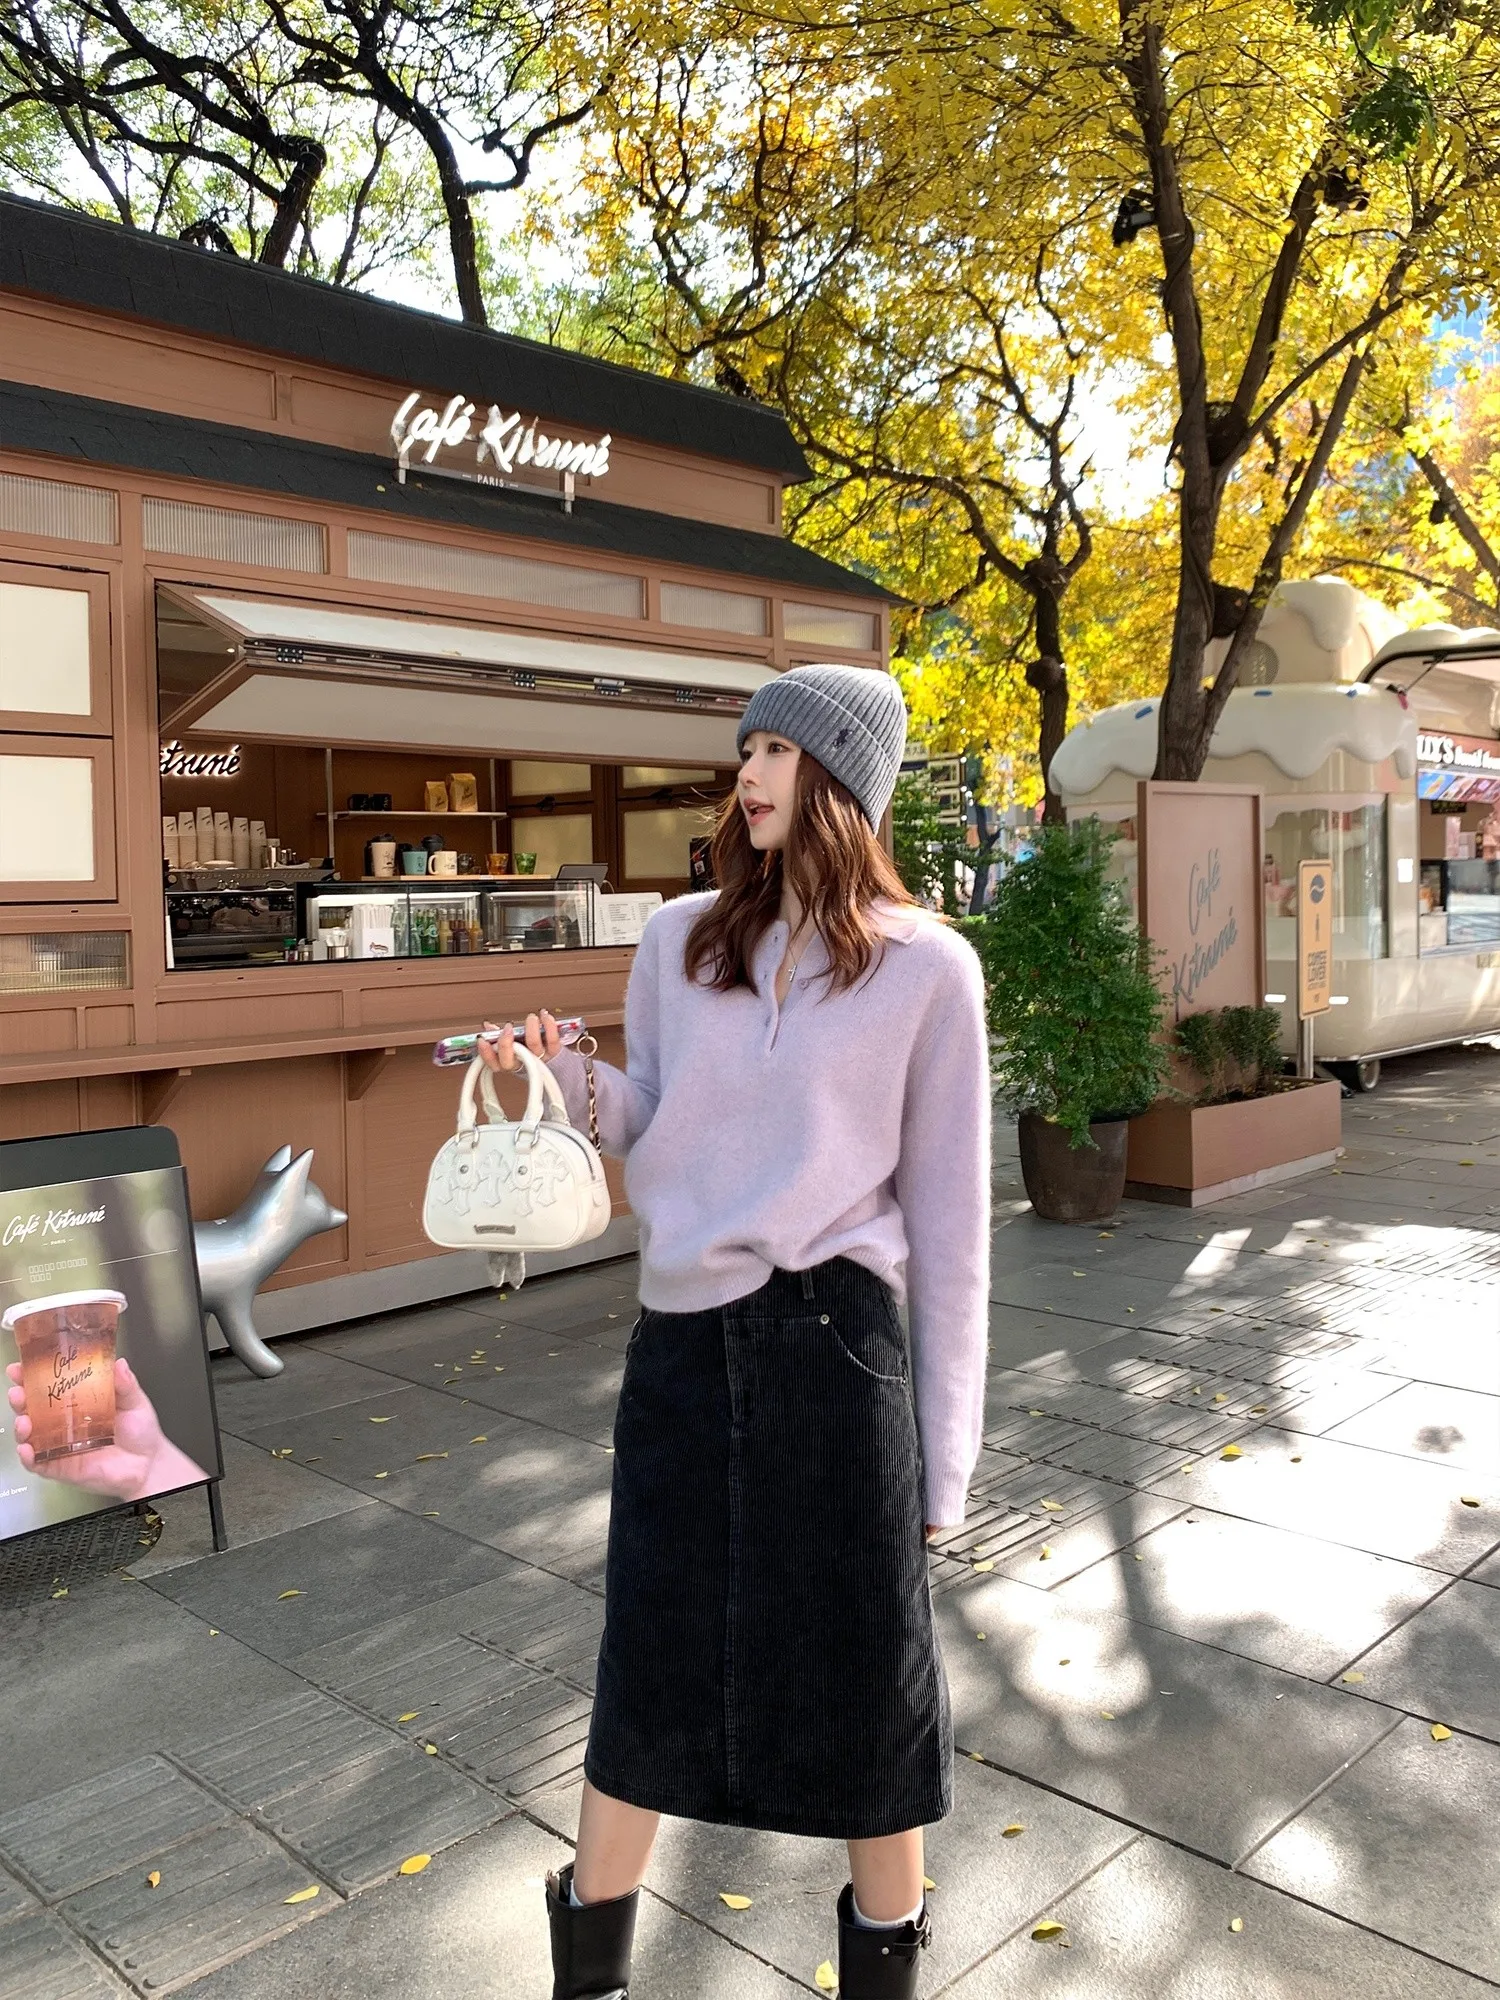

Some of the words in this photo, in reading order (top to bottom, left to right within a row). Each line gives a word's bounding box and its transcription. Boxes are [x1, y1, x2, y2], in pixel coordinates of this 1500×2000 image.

[390, 391, 476, 464] Café
[477, 403, 613, 478] Kitsuné
[477, 474, 504, 488] PARIS
[160, 740, 242, 775] tsuné
[1188, 848, 1221, 936] Café
[1172, 906, 1238, 1022] Kitsuné
[2, 1214, 41, 1247] Café
[42, 1204, 106, 1237] Kitsuné
[53, 1345, 78, 1379] Café
[47, 1361, 94, 1408] Kitsuné
[0, 1488, 10, 1498] old
